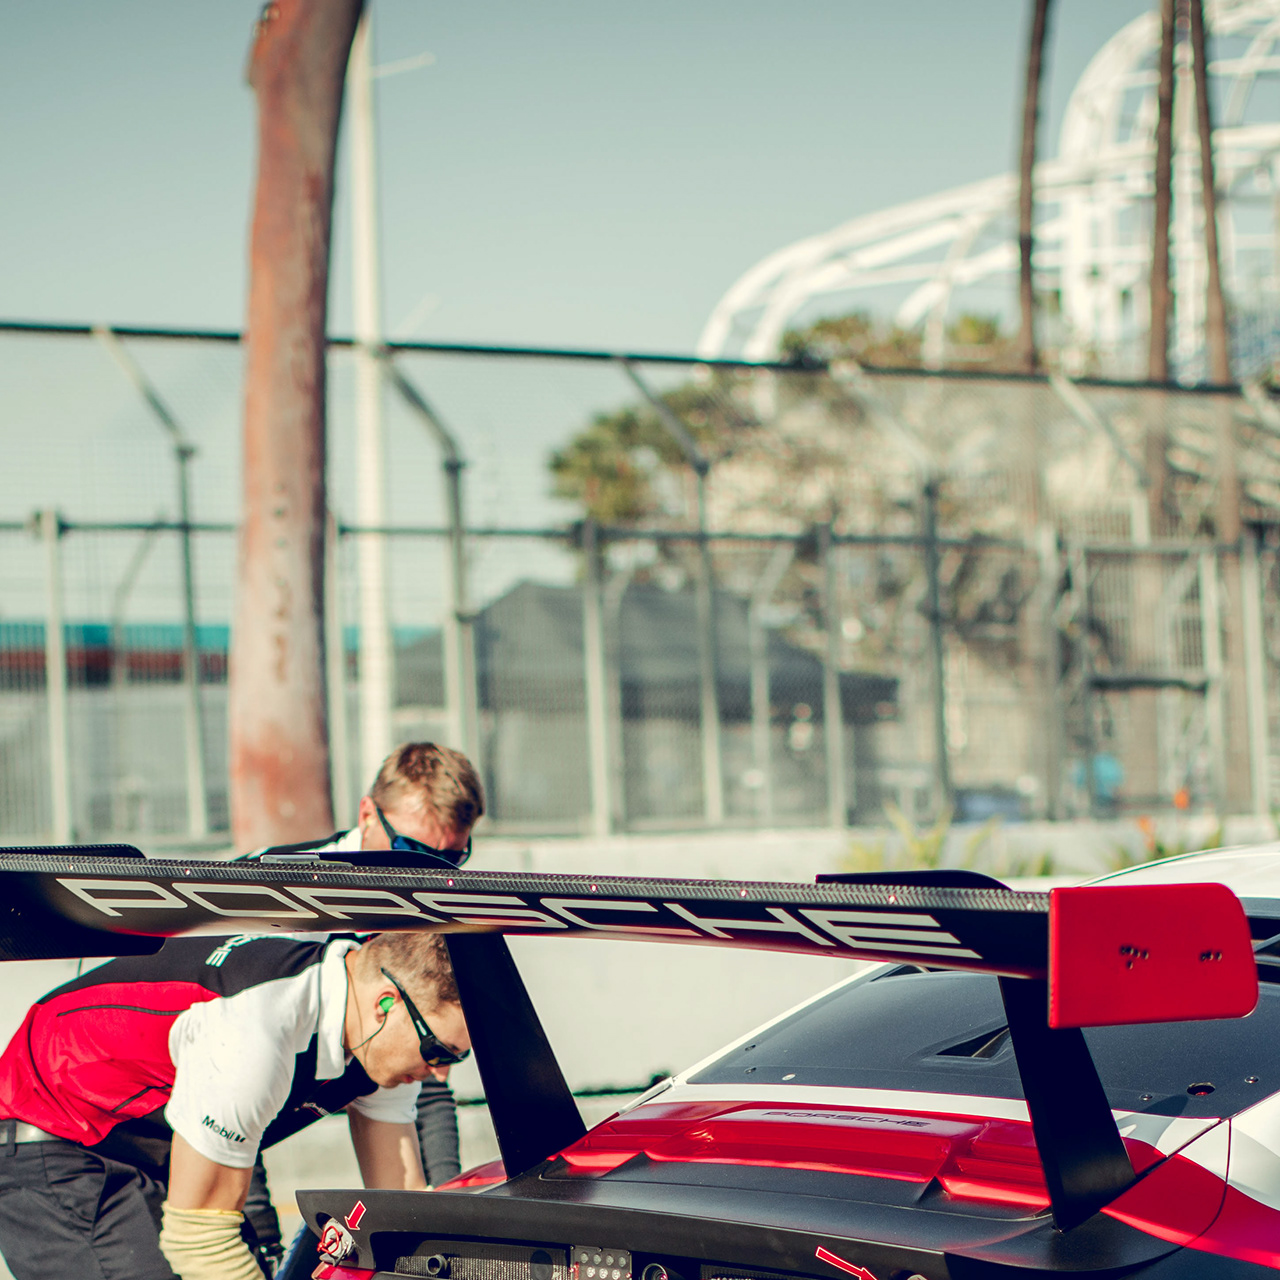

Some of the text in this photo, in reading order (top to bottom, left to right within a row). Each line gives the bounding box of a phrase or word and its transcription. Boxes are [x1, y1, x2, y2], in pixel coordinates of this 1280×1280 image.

[56, 877, 984, 959] PORSCHE
[202, 1115, 235, 1140] Mobil
[762, 1111, 932, 1128] PORSCHE
